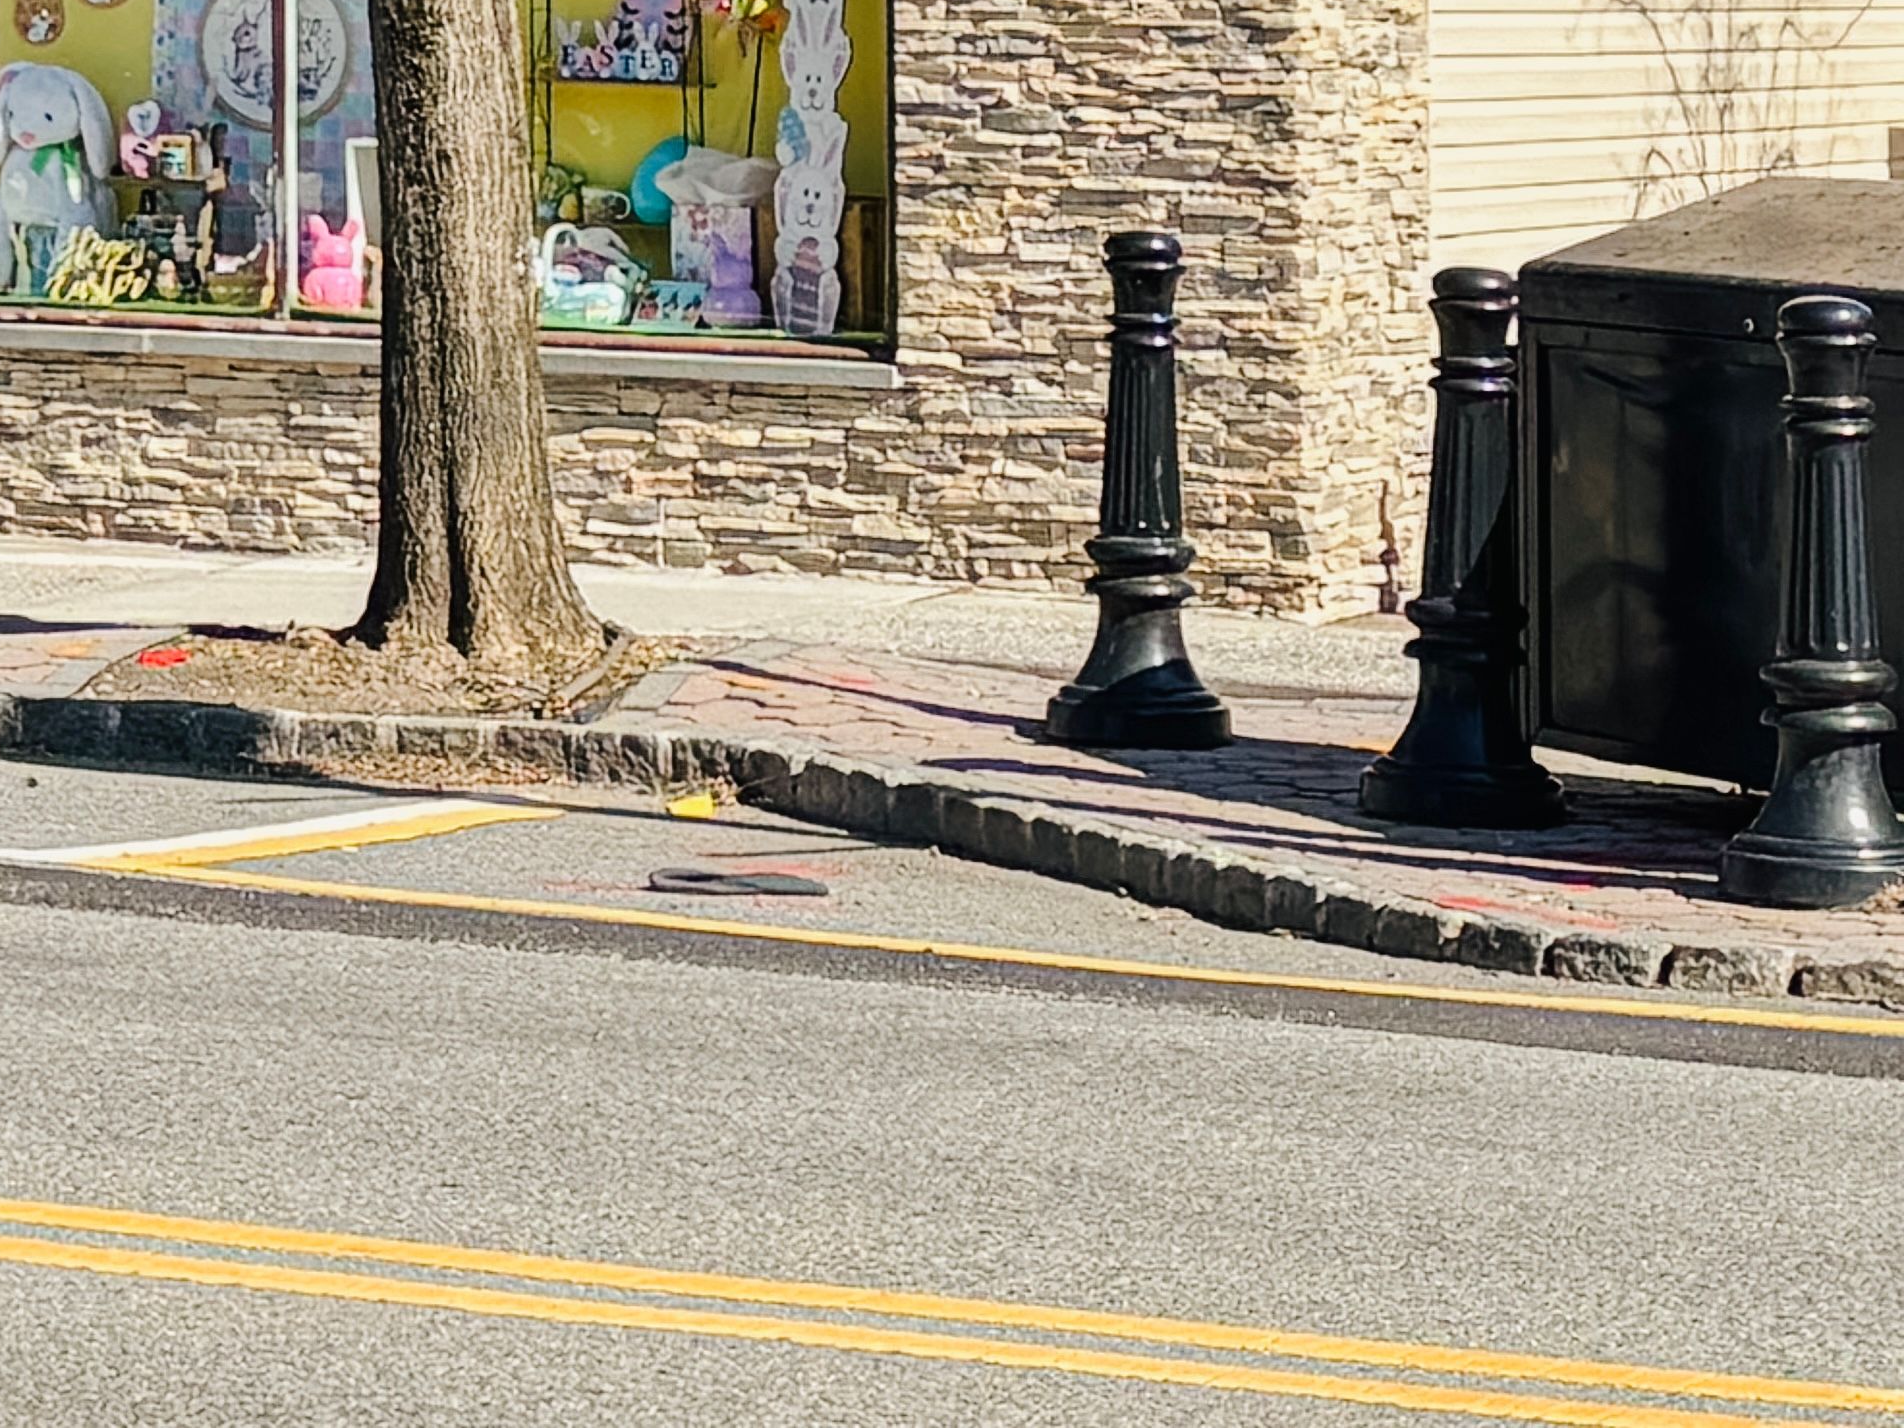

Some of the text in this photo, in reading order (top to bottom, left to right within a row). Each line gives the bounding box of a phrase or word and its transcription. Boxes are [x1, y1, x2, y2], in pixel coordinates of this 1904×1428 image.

[561, 43, 674, 77] EASTER
[47, 224, 146, 278] Happy
[43, 262, 152, 304] Easter
